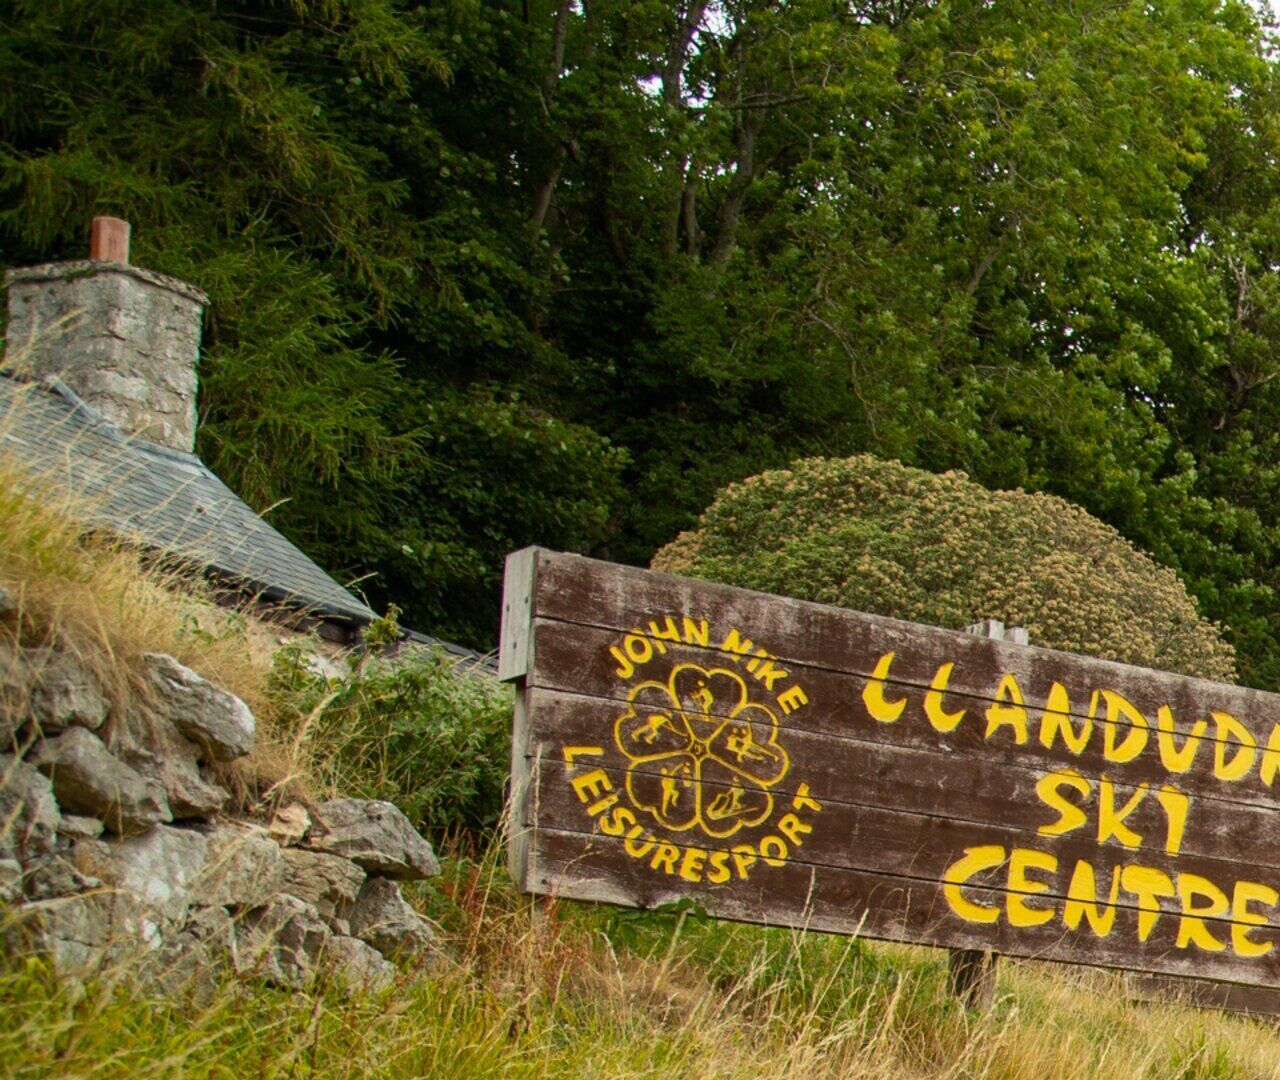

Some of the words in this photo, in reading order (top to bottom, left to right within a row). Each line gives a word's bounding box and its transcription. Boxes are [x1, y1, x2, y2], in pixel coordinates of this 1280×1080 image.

[609, 616, 710, 679] JOHN
[720, 628, 809, 715] NIKE
[563, 745, 823, 883] LEISURESPORT
[1035, 768, 1190, 856] SKI
[943, 843, 1280, 957] CENTRE
